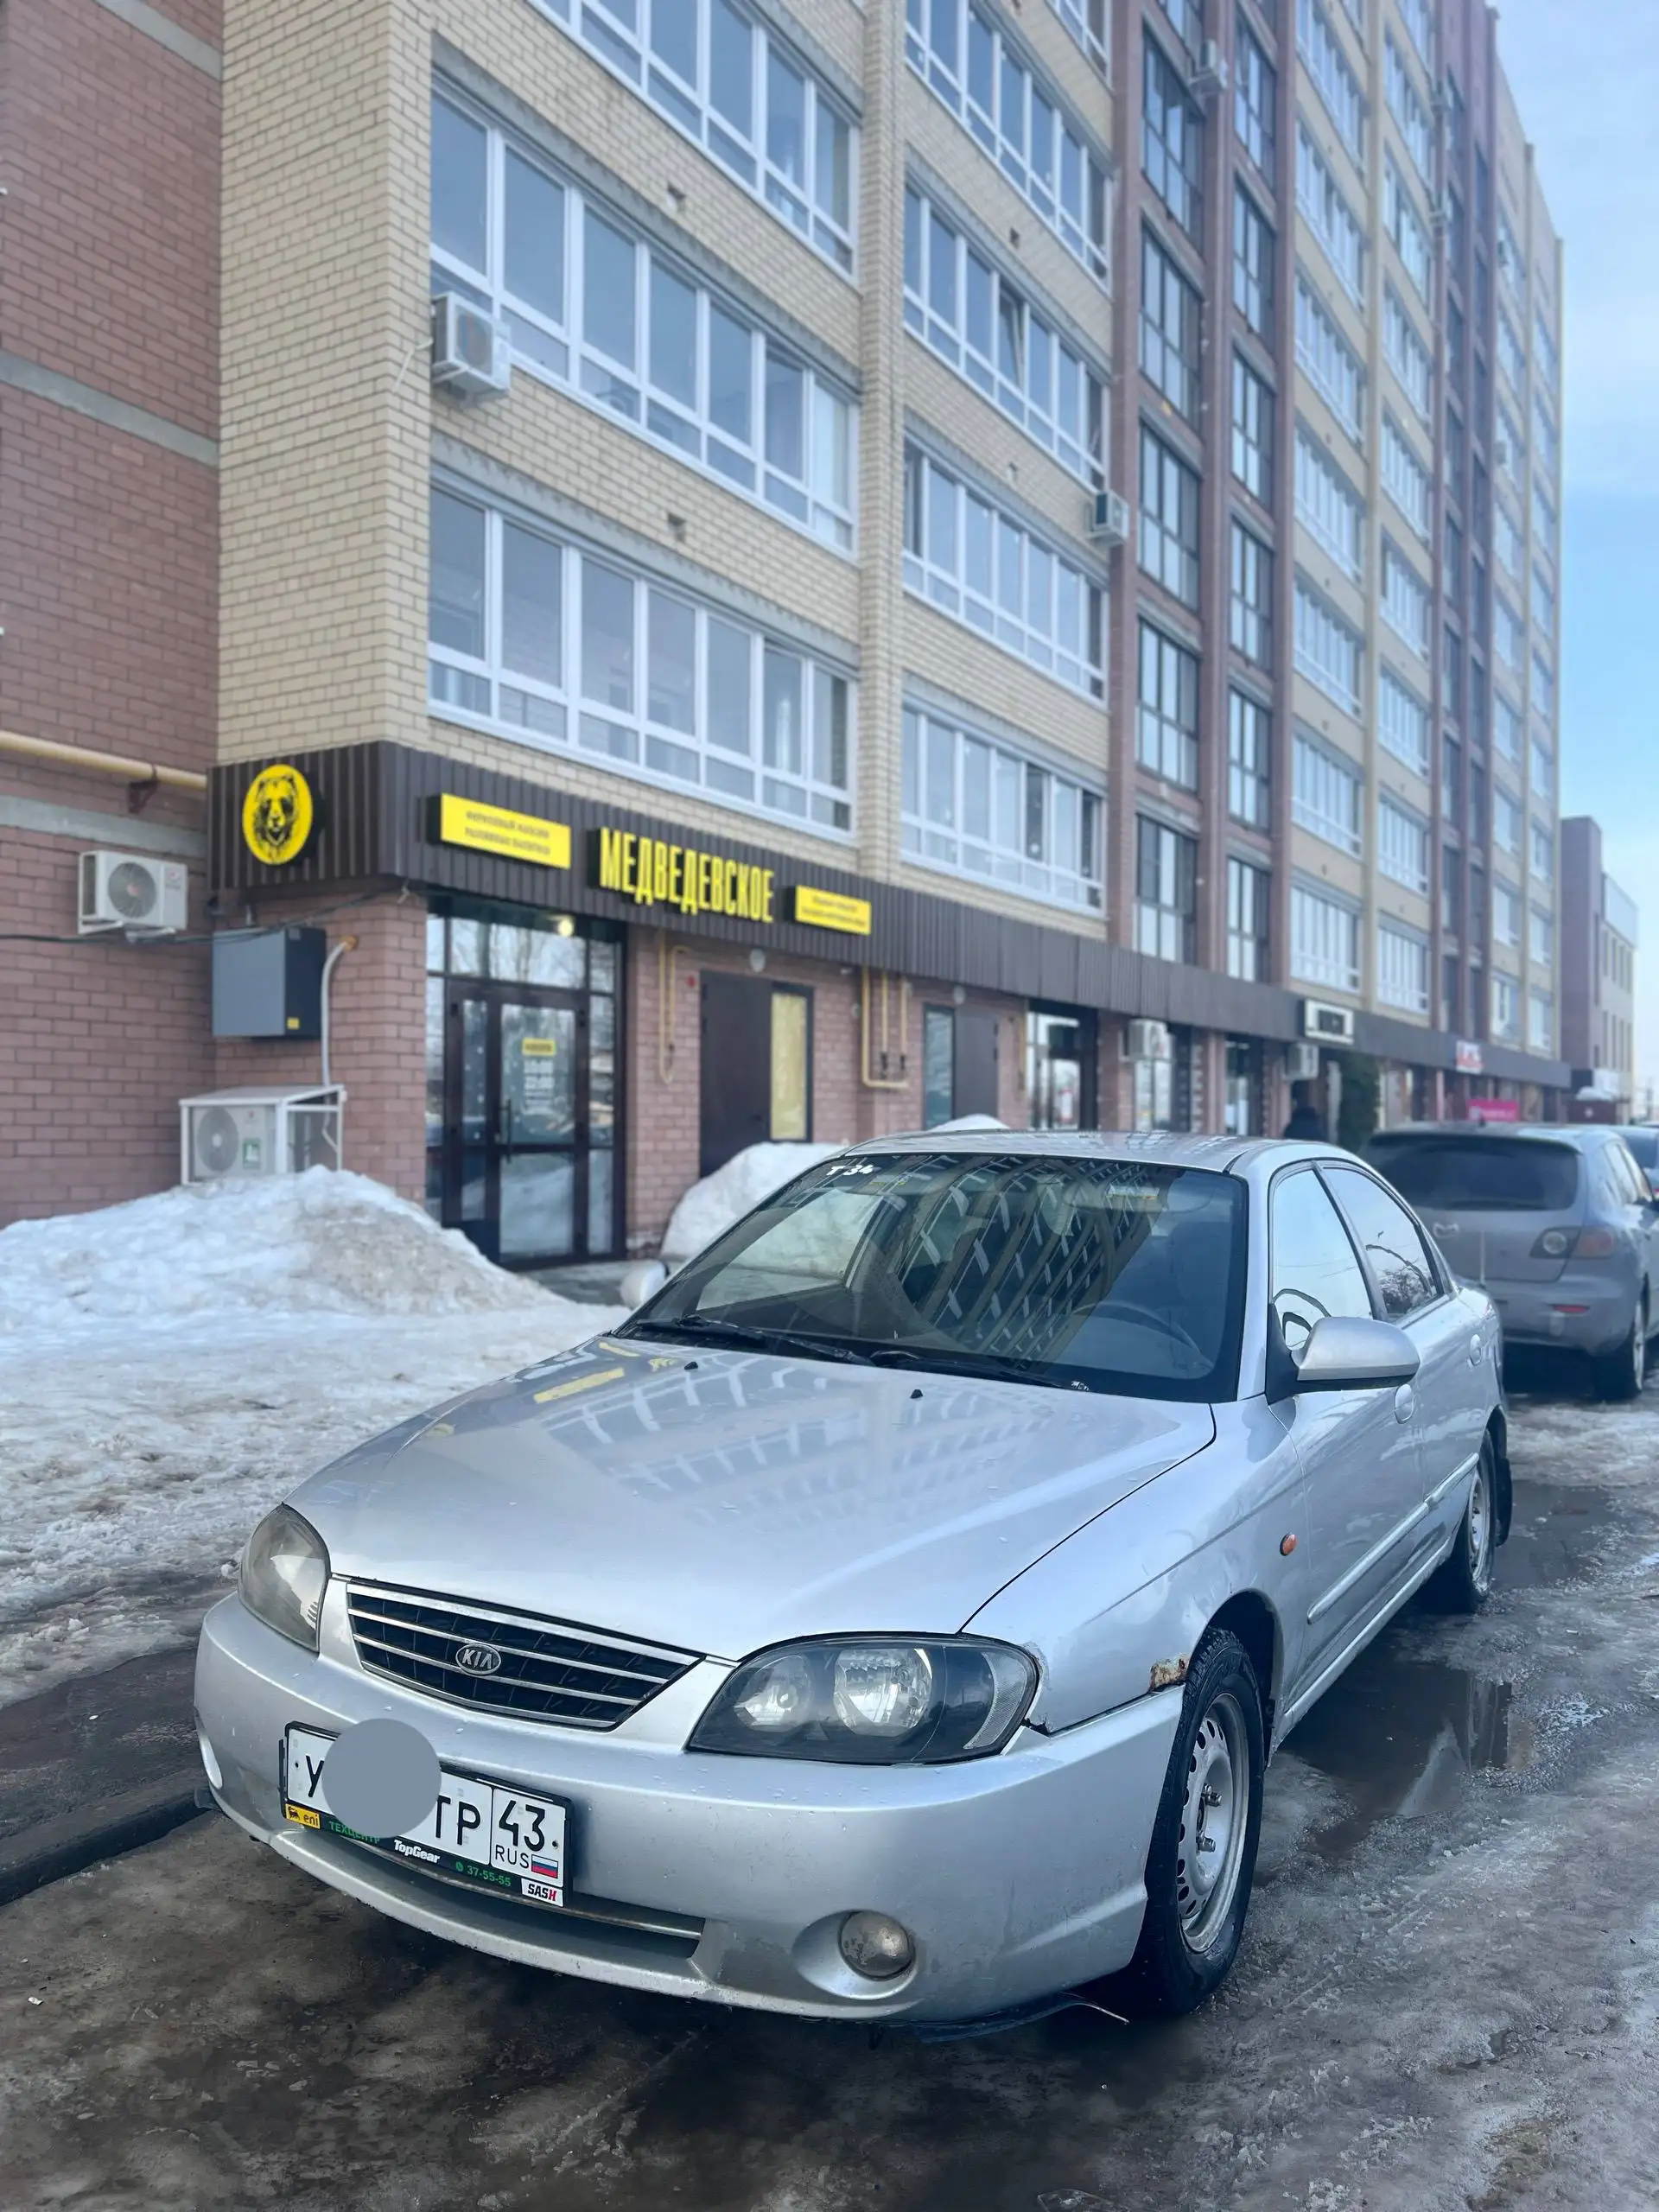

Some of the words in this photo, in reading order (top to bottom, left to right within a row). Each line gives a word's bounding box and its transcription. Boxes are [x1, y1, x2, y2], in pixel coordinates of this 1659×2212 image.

[600, 826, 774, 923] МЕДВЕДЕВСКОЕ
[461, 1649, 493, 1669] KIA
[303, 1814, 319, 1827] eni
[499, 1800, 546, 1852] 43
[394, 1839, 441, 1865] TopGear
[495, 1843, 530, 1869] RUS
[528, 1884, 557, 1901] SASH
